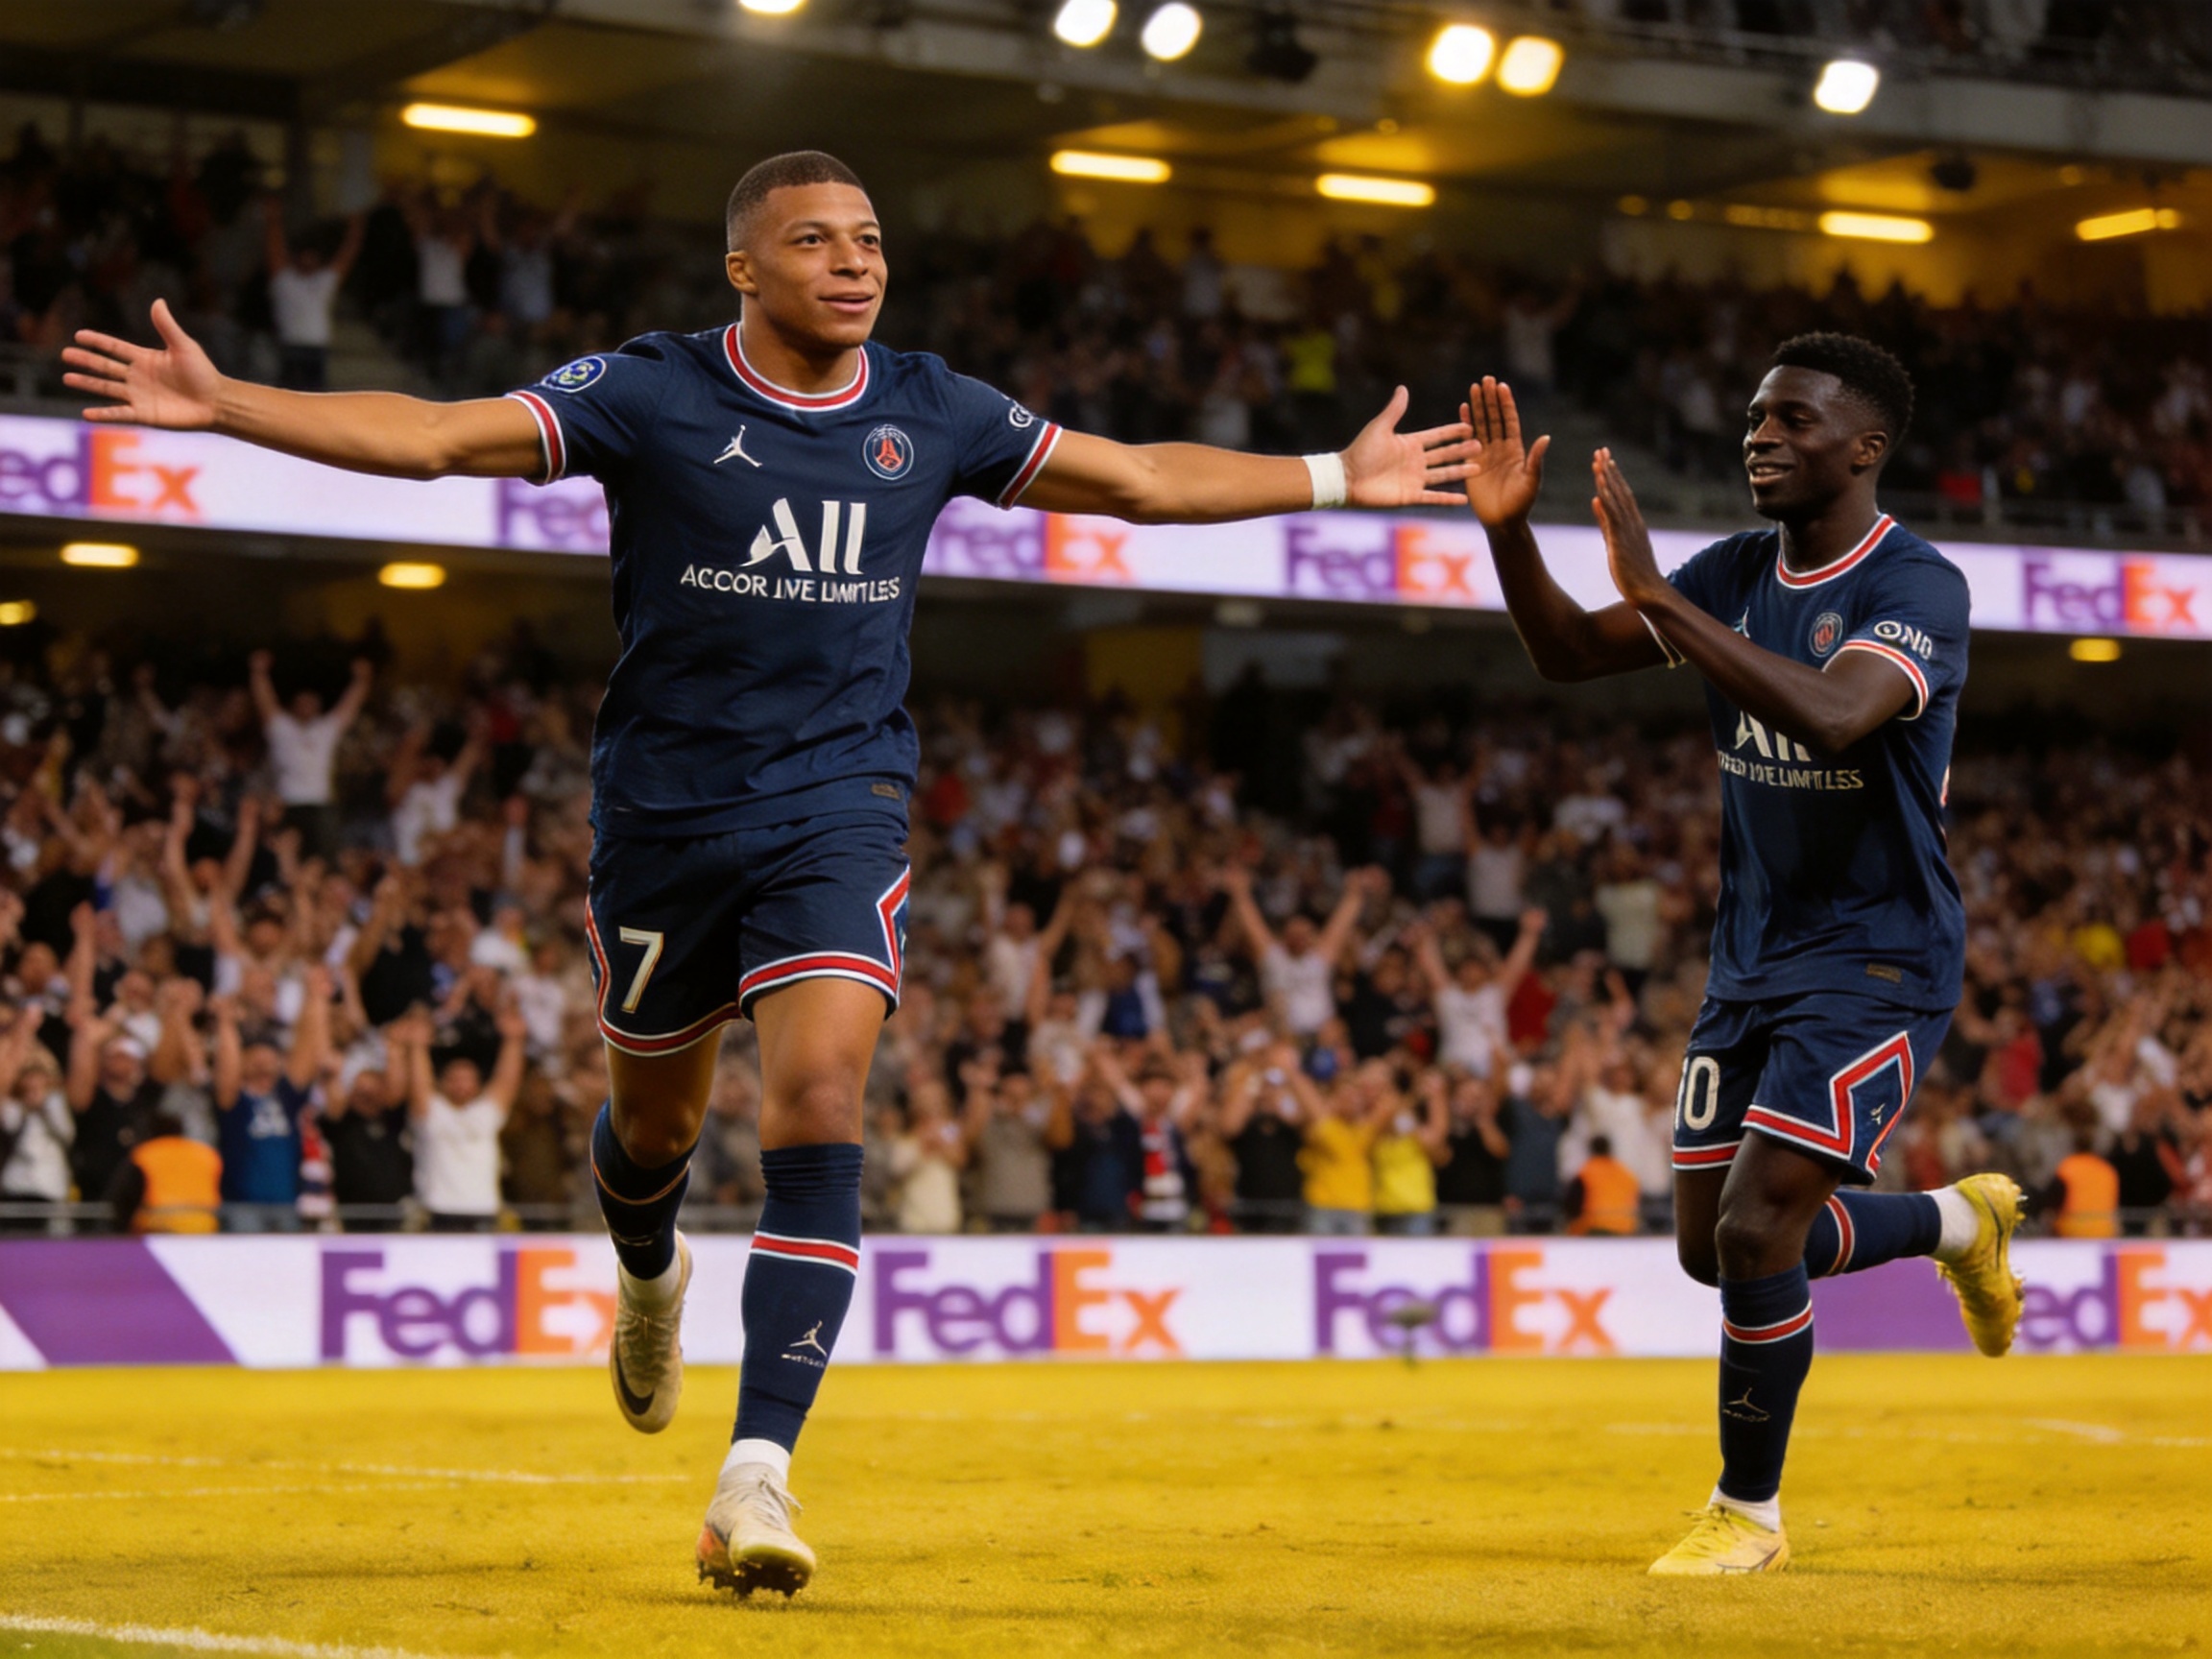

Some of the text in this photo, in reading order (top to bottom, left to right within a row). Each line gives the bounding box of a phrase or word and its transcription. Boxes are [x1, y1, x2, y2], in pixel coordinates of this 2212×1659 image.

[680, 563, 768, 597] ACCOR
[1285, 518, 1475, 602] FedEx
[2021, 553, 2200, 636] FedEx
[618, 926, 664, 1014] 7
[872, 1244, 1185, 1356] FedEx
[1312, 1246, 1619, 1356] FedEx
[2021, 1247, 2212, 1351] edEx
